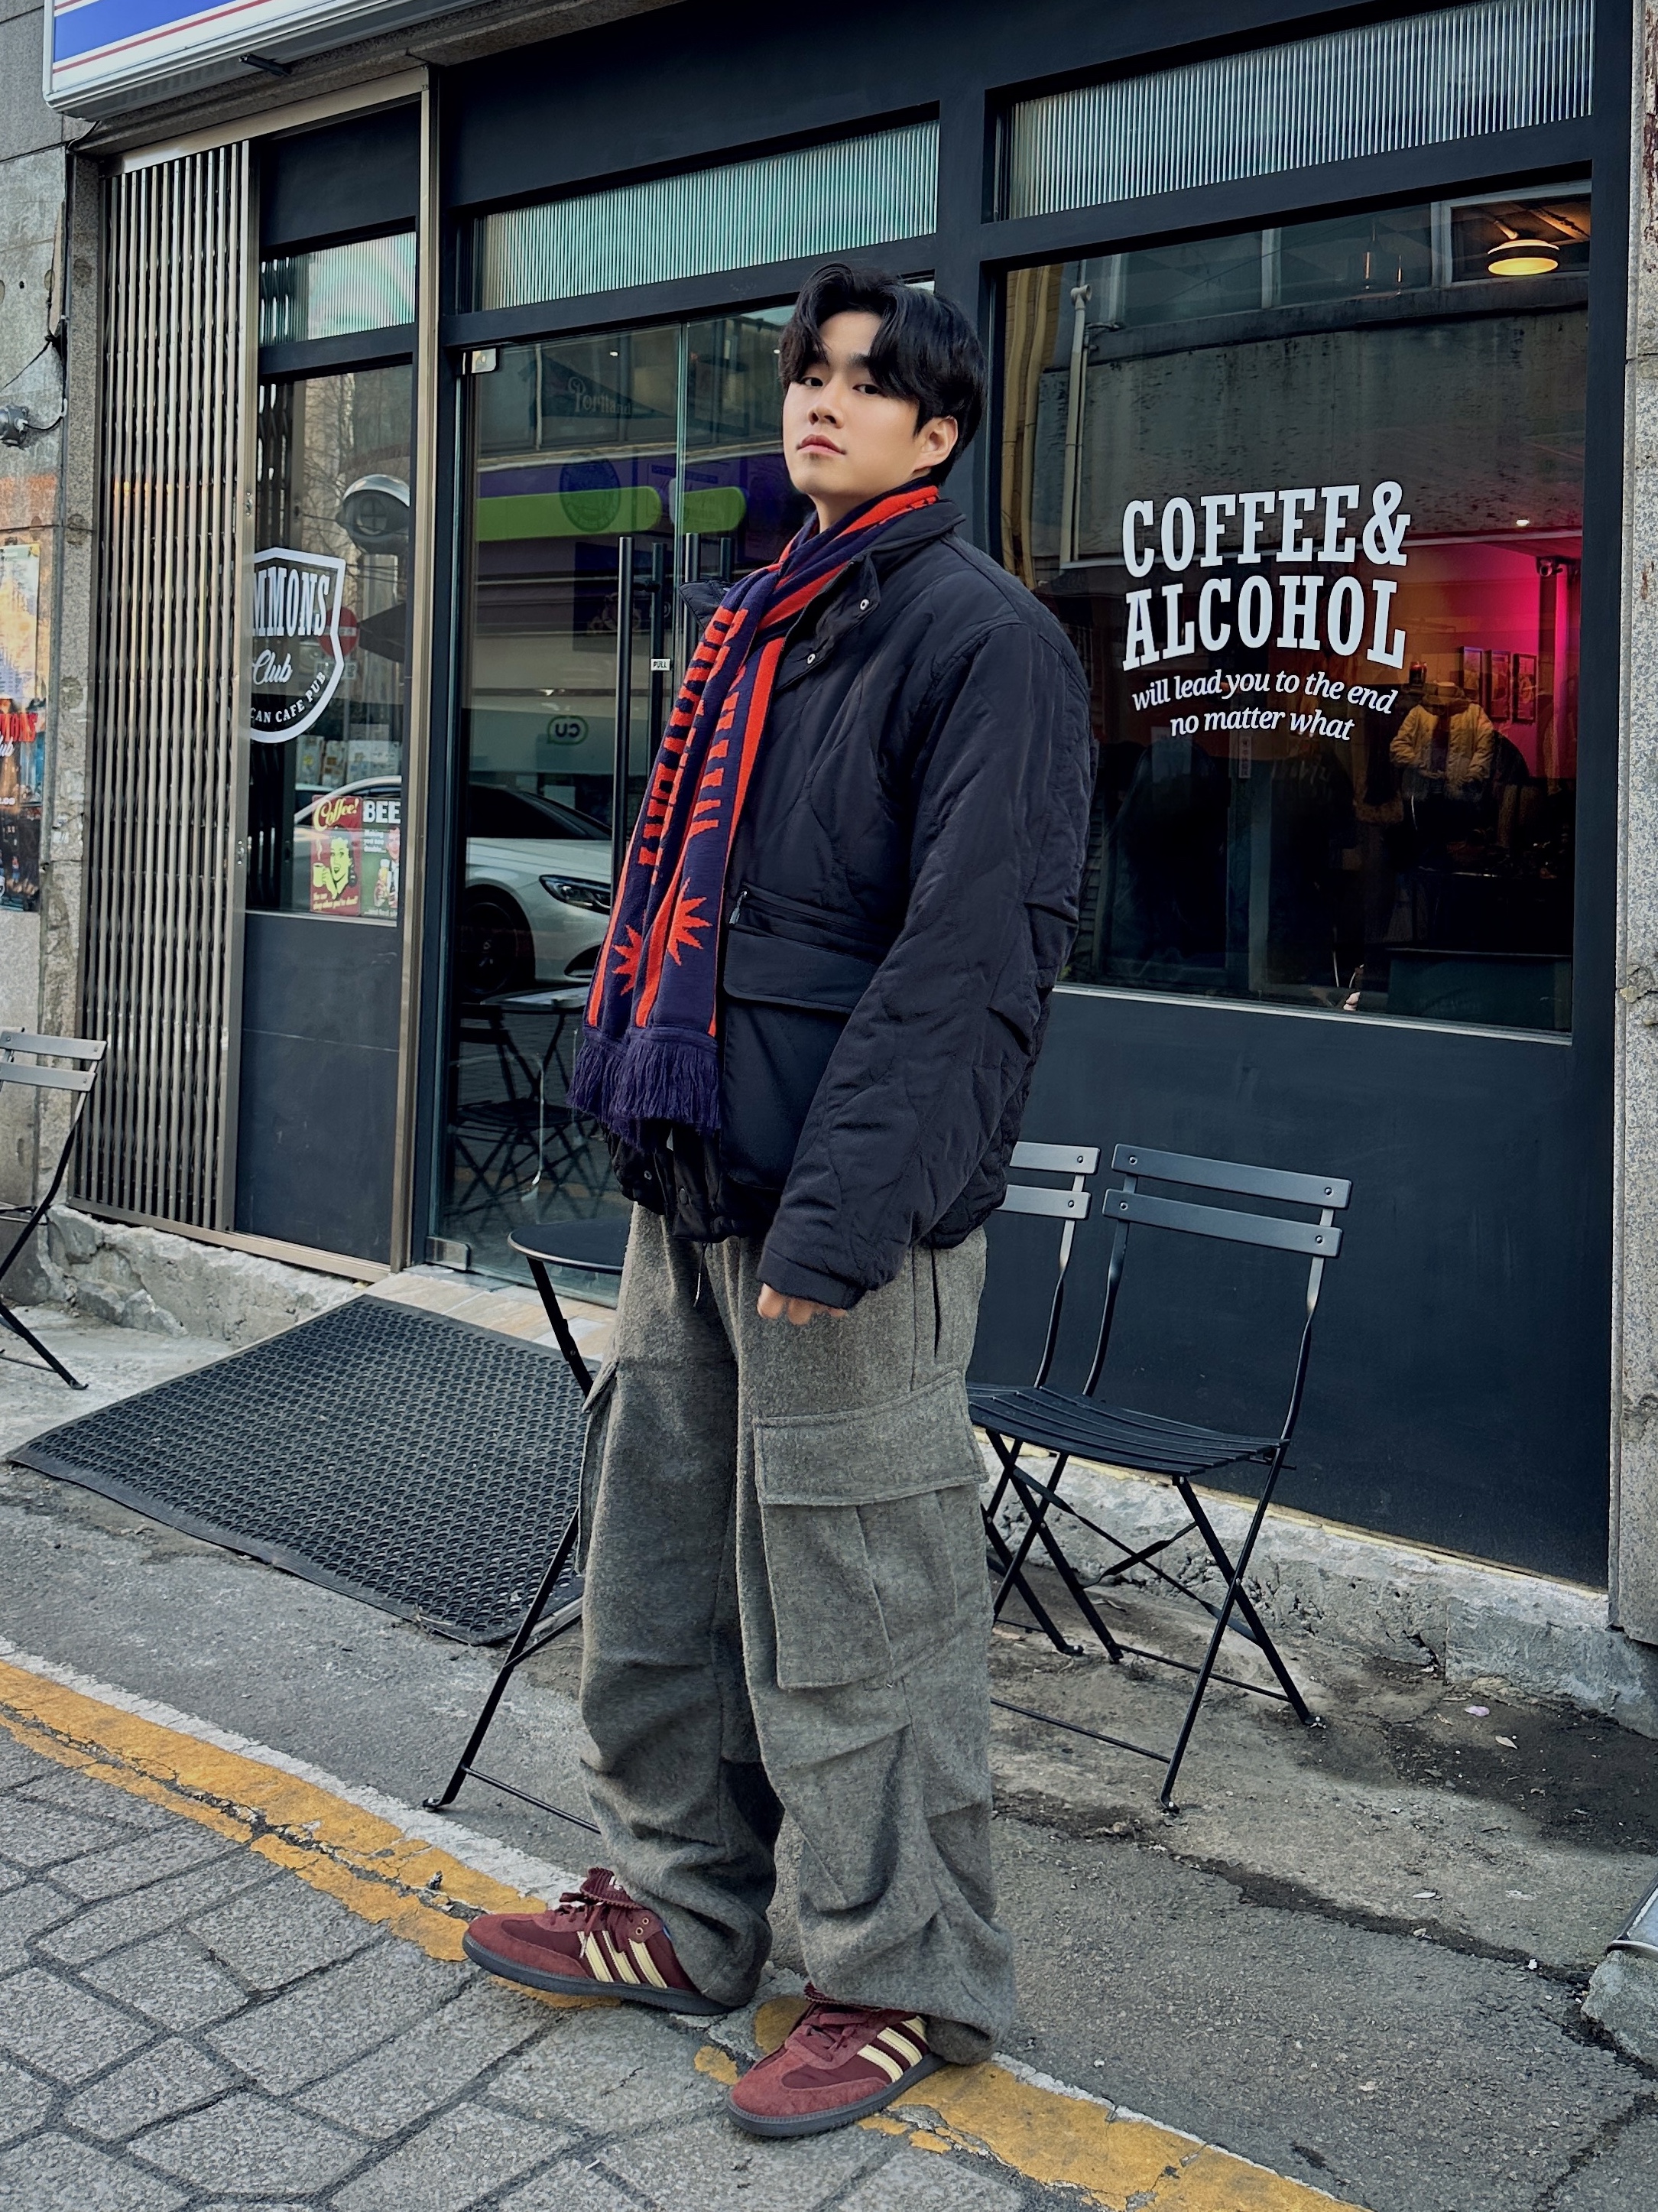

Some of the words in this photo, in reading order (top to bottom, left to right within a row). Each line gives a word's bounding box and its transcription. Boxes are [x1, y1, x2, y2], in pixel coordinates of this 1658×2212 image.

[1122, 575, 1406, 671] ALCOHOL
[251, 649, 293, 685] Club
[653, 661, 667, 669] PULL
[275, 699, 305, 723] CAFE
[306, 671, 326, 703] PUB
[1131, 678, 1171, 711] will
[1173, 668, 1223, 700] lead
[1222, 673, 1270, 700] you
[1275, 670, 1300, 693] to
[1304, 671, 1345, 700] the
[1347, 685, 1399, 714] end
[1170, 715, 1199, 737] no
[1203, 706, 1286, 731] matter
[1290, 709, 1355, 741] what
[313, 797, 359, 832] Coffee!
[363, 801, 401, 824] BEE
